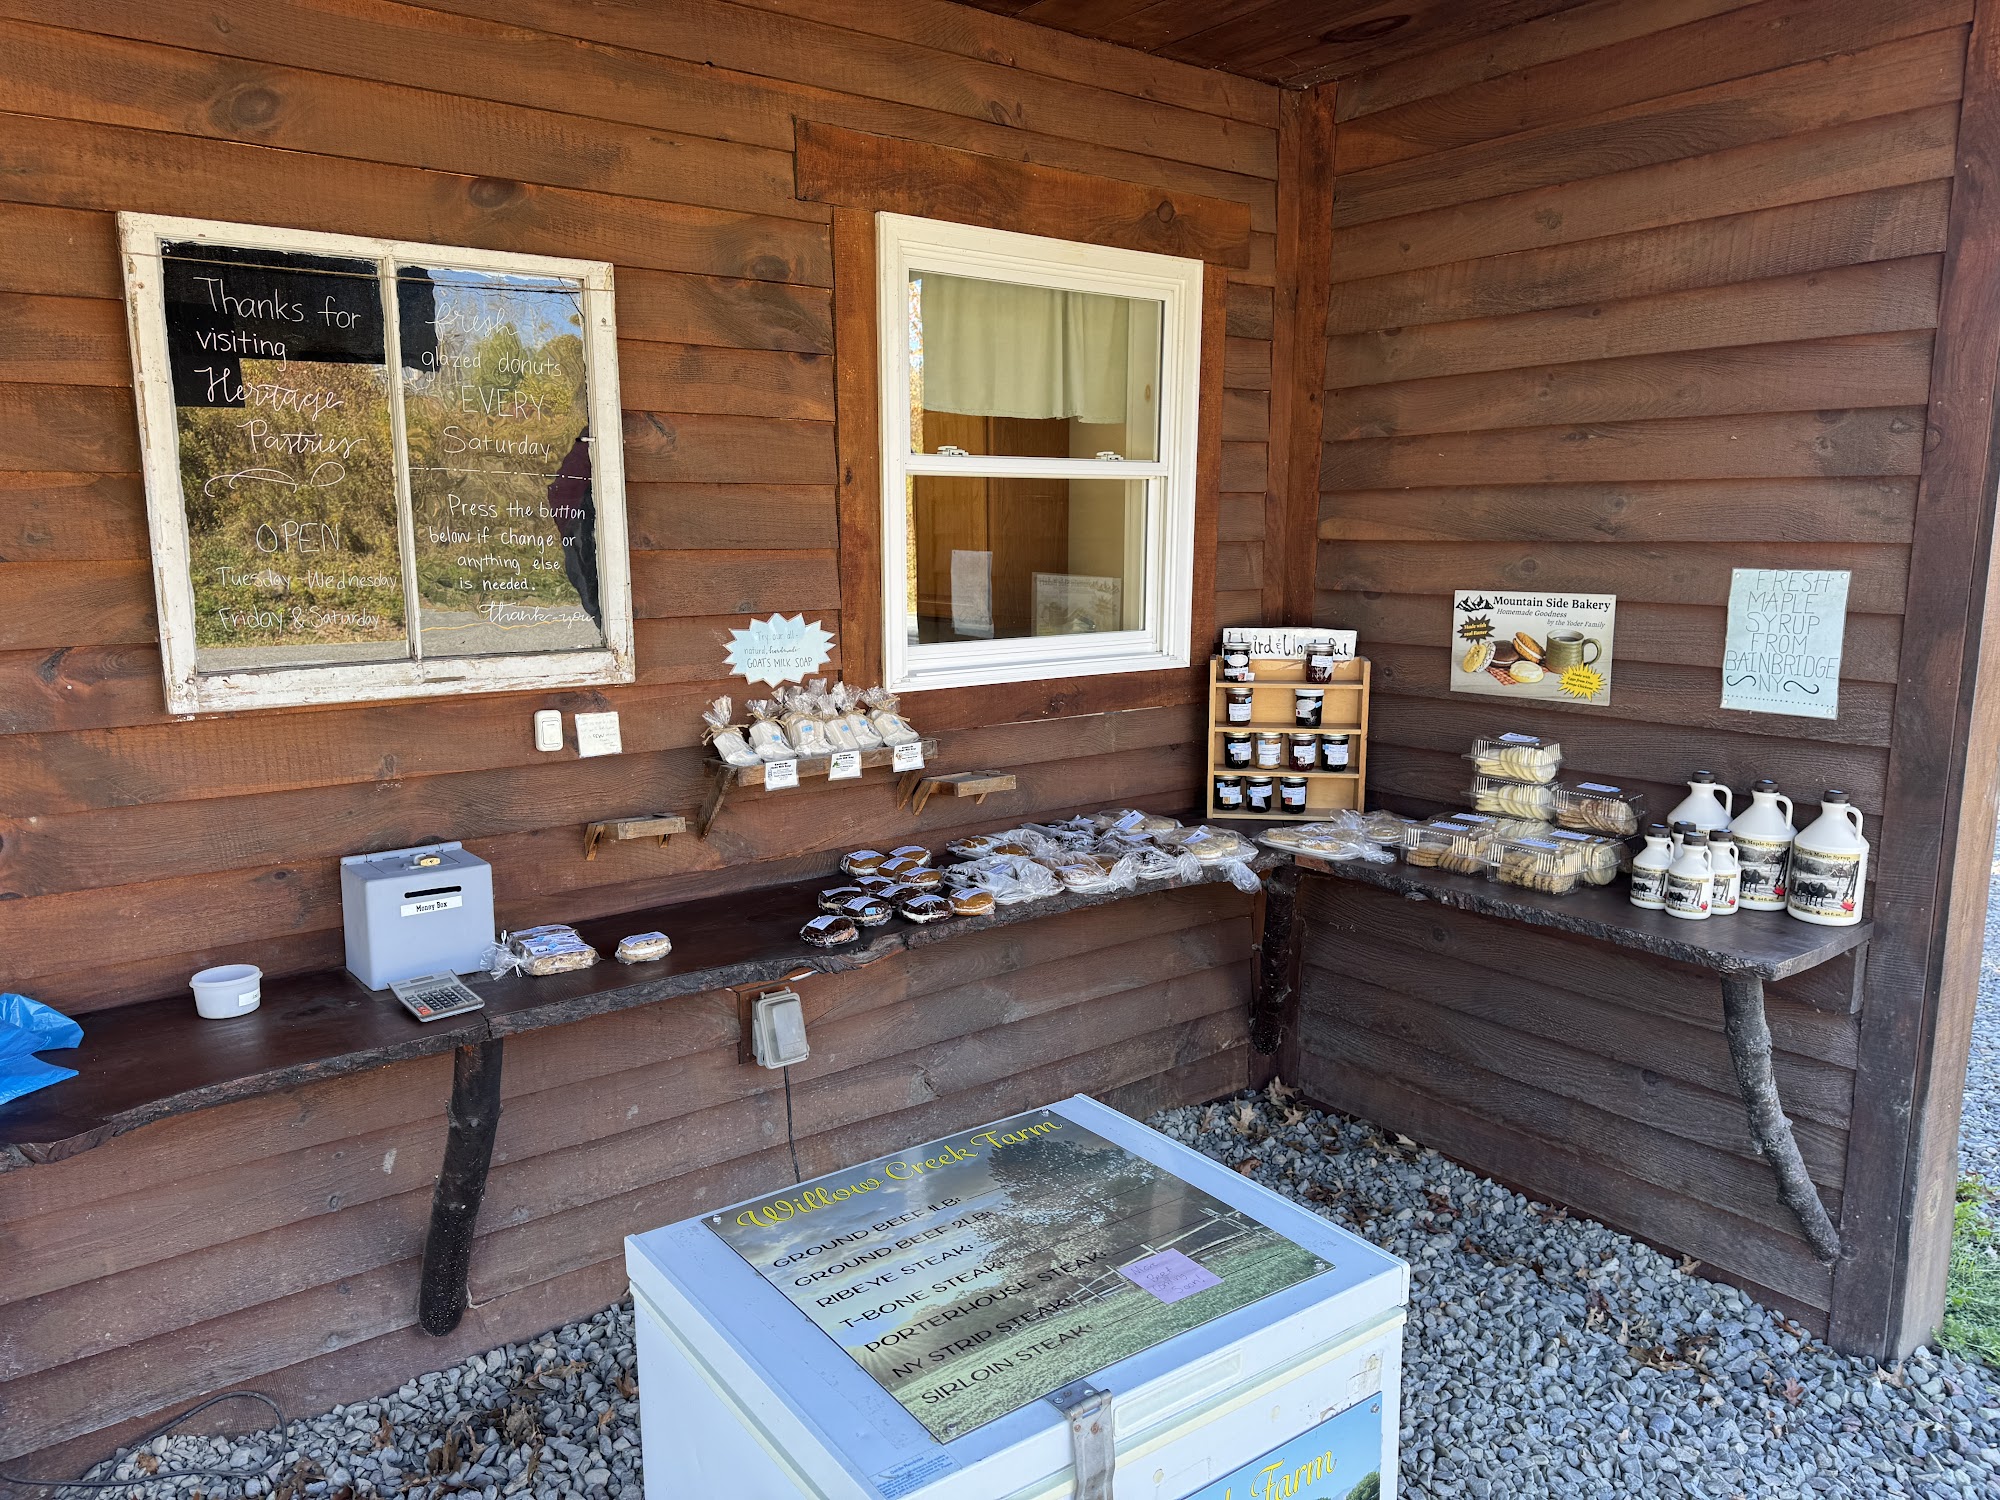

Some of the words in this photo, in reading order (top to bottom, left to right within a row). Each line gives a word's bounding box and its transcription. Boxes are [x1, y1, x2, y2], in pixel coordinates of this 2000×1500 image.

[193, 277, 304, 323] Thanks
[317, 296, 361, 329] for
[425, 302, 518, 341] fresh
[196, 328, 287, 371] visiting
[421, 346, 481, 390] glazed
[498, 352, 562, 376] donuts
[193, 367, 344, 421] Heritage
[461, 385, 545, 420] EVERY
[236, 418, 367, 459] Pastries
[443, 425, 551, 463] Saturday
[448, 493, 498, 518] Press
[506, 500, 534, 517] the
[539, 501, 586, 519] button
[256, 520, 340, 553] OPEN
[428, 526, 471, 543] below
[477, 526, 490, 543] if
[500, 531, 554, 554] change
[562, 535, 577, 547] or
[216, 566, 291, 591] Tuesday
[307, 570, 397, 593] Wednesday
[457, 553, 520, 575] anything
[532, 557, 561, 570] else
[459, 577, 473, 589] is
[483, 577, 536, 591] needed.
[1756, 570, 1832, 593] FRESH
[218, 604, 283, 634] Friday
[291, 605, 306, 630] &
[309, 605, 380, 630] Saturday
[1493, 596, 1543, 607] Mountain
[1546, 597, 1569, 608] Side
[1572, 599, 1611, 612] Bakery
[1496, 608, 1533, 617] Homemade
[1534, 610, 1568, 618] Goodness
[1746, 591, 1819, 614] MAPLE
[1546, 619, 1555, 627] by
[1566, 620, 1584, 628] Yoder
[1585, 621, 1606, 630] Family
[1745, 611, 1821, 635] SYRUP
[1751, 632, 1808, 655] FROM
[773, 658, 791, 668] MILK
[795, 656, 813, 668] SOAP
[1724, 650, 1839, 680] BAINBRIDGE
[1759, 674, 1785, 693] NY
[416, 903, 435, 912] Money
[735, 1177, 884, 1228] Willow
[885, 1145, 978, 1181] Creek
[971, 1120, 1063, 1150] Farm
[773, 1229, 869, 1268] GROUND
[872, 1208, 925, 1233] BEEF
[794, 1246, 893, 1288] GROUND
[894, 1225, 948, 1250] BEEF
[954, 1210, 992, 1230] 2LB:
[815, 1272, 901, 1309] RIBEYE
[900, 1243, 974, 1276] STEAK:
[838, 1289, 930, 1328] T-BONE
[931, 1261, 1005, 1294] STEAK:
[864, 1279, 1036, 1353] PORTERHOUSE
[1037, 1252, 1107, 1282] STEAK:
[892, 1357, 924, 1379] NY
[928, 1329, 993, 1362] STRIP
[995, 1298, 1071, 1333] STEAK:
[920, 1357, 1015, 1405] SIRLOIN
[1016, 1323, 1092, 1362] STEAK:
[1250, 1450, 1337, 1500] Farm
